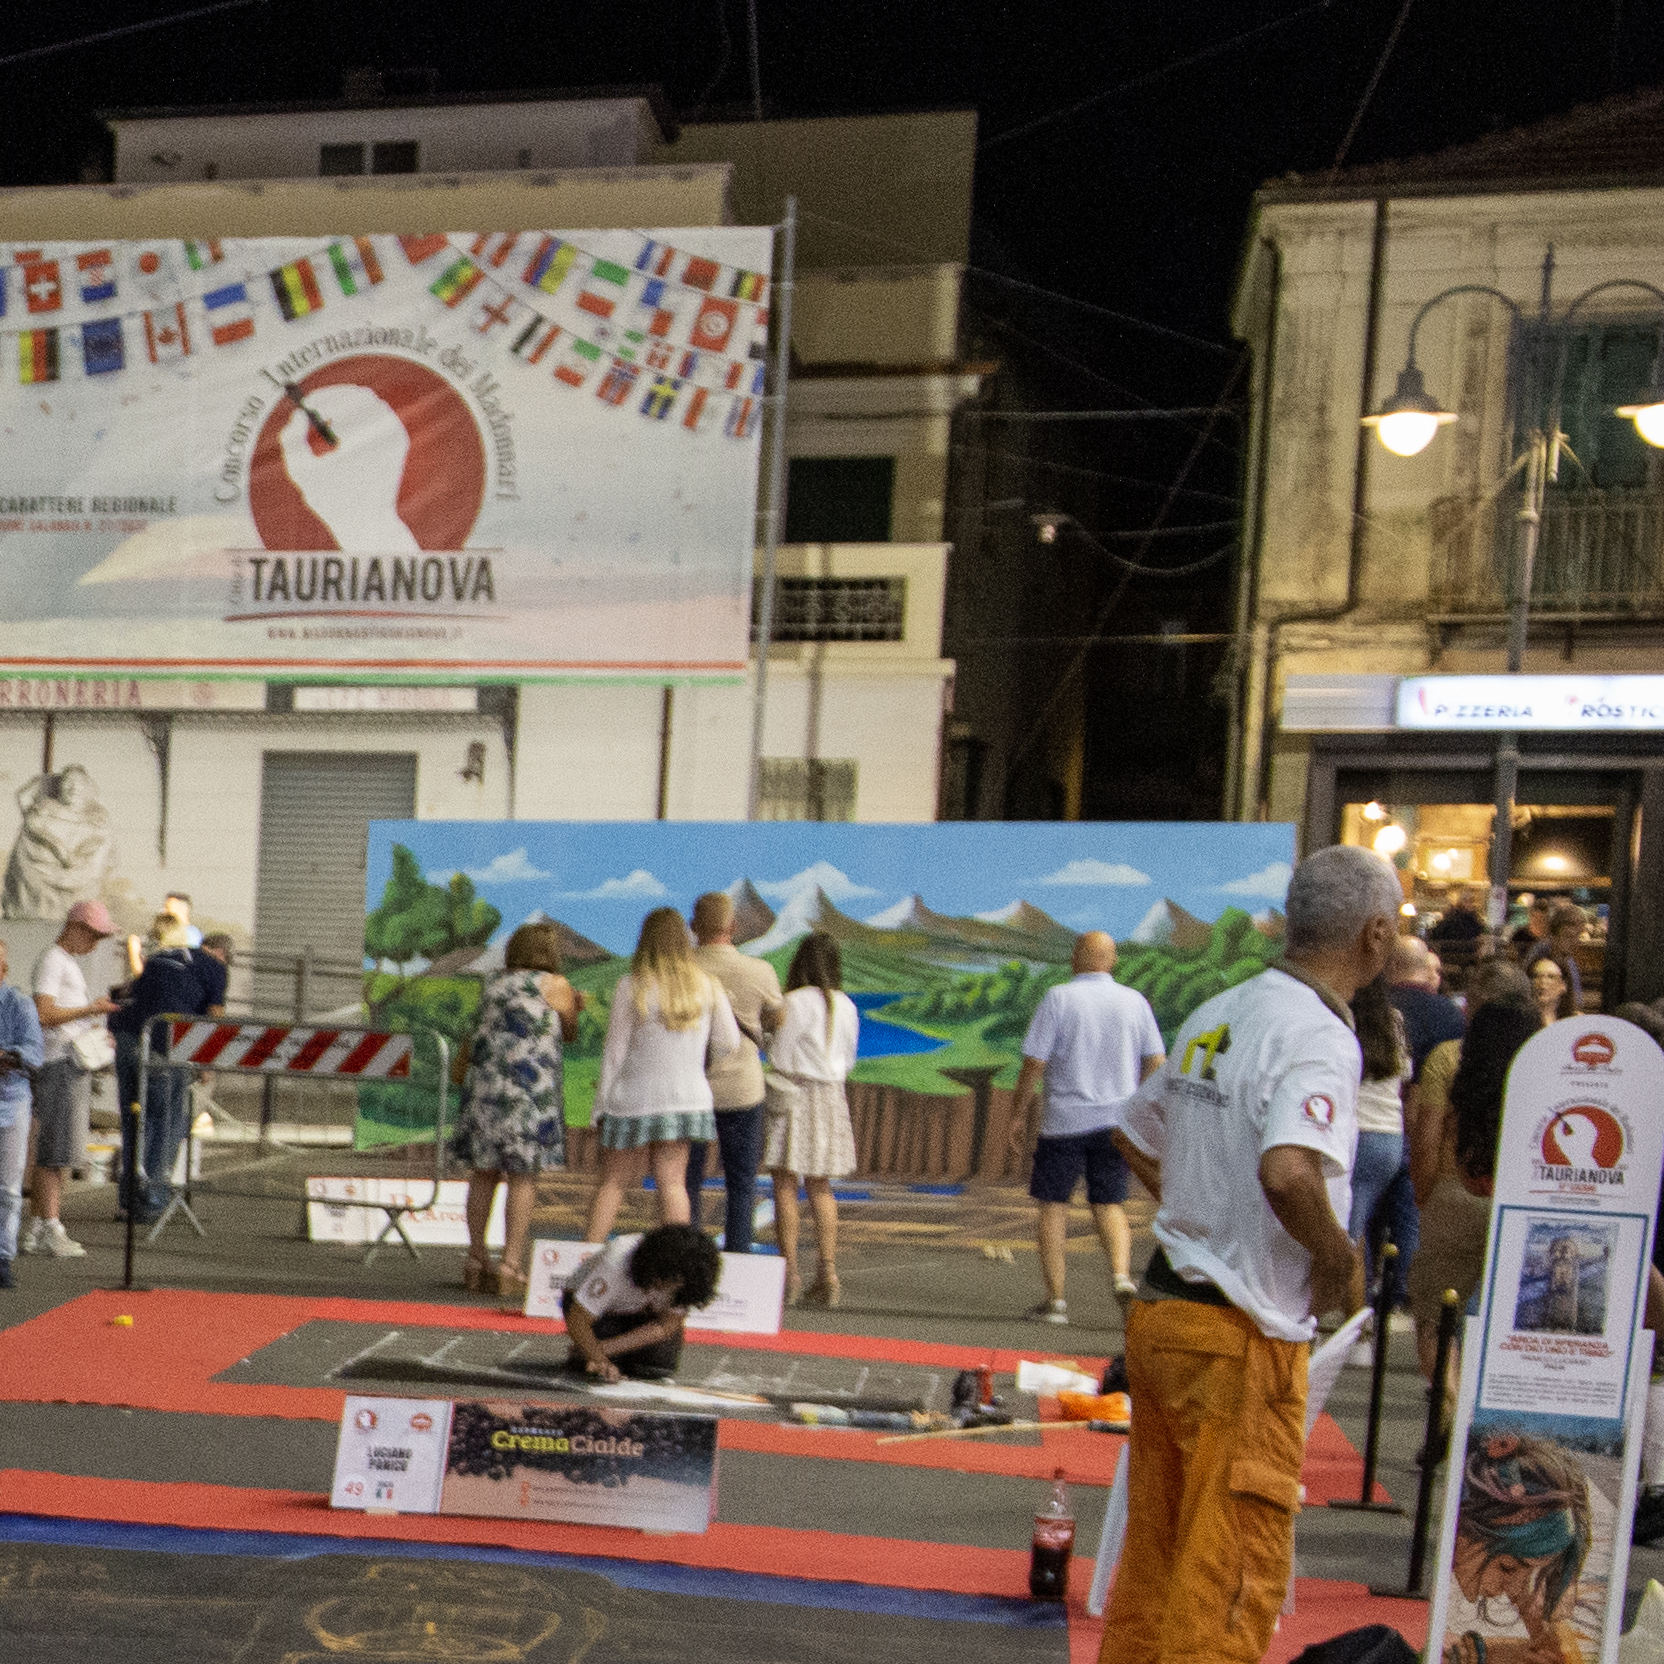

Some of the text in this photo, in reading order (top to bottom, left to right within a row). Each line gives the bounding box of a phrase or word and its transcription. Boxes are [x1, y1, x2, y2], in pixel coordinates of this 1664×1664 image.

[258, 321, 438, 388] Internazionale
[91, 495, 177, 515] REGIONALE
[249, 556, 497, 602] TAURIANOVA
[1435, 704, 1533, 718] PZZERIA
[1539, 1166, 1624, 1185] TAURIANOVA
[344, 1480, 365, 1497] 49
